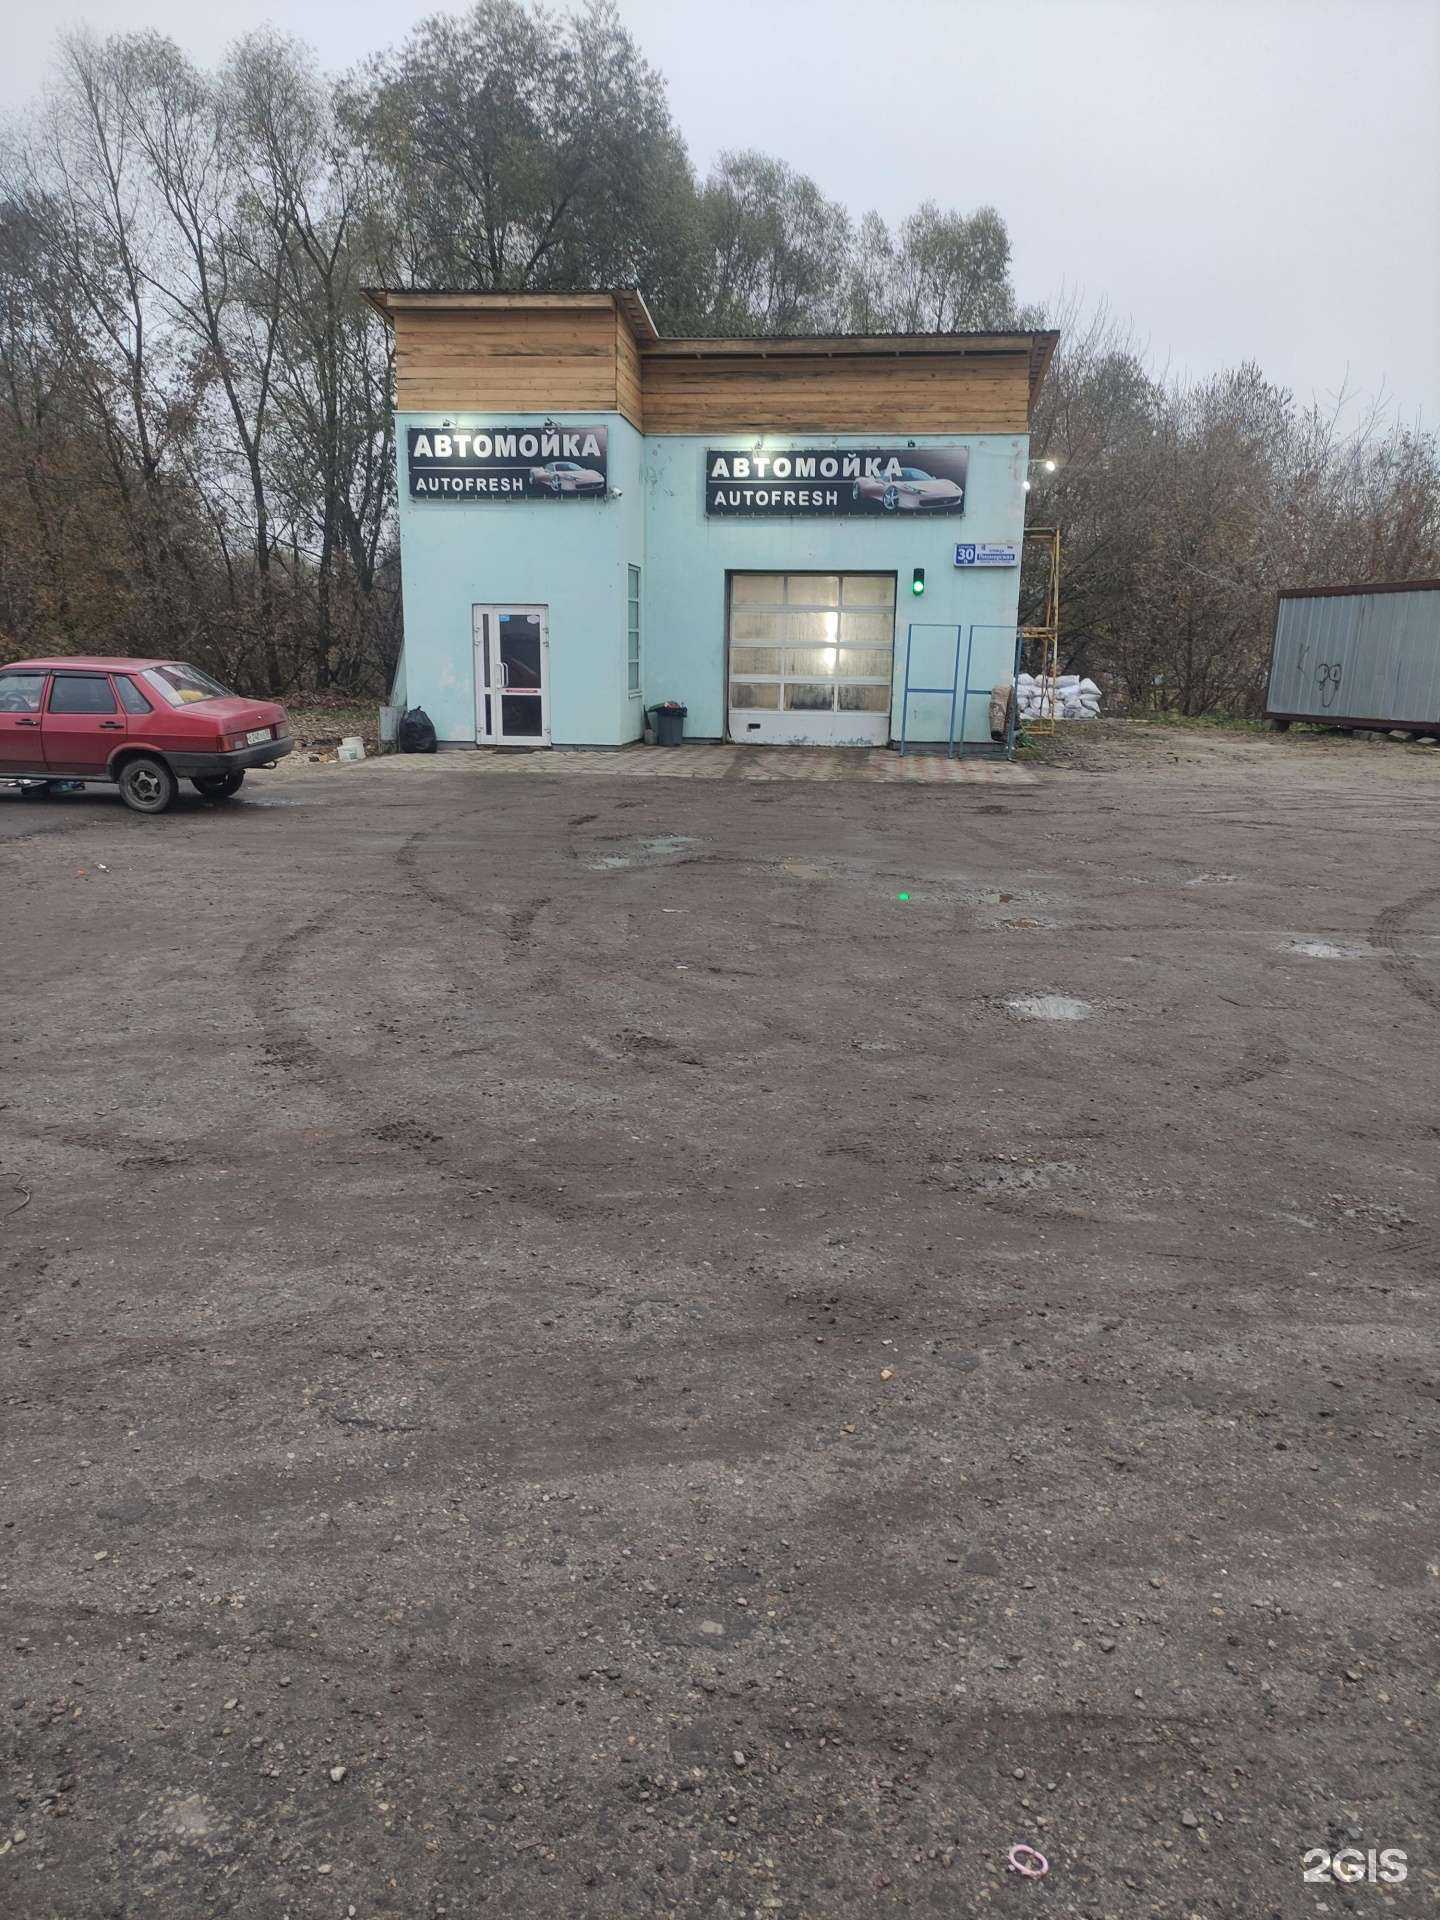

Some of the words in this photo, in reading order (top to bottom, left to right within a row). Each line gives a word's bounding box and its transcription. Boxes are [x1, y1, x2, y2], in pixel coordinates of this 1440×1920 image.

[413, 429, 601, 458] АВТОМОЙКА
[711, 453, 903, 478] АВТОМОЙКА
[416, 477, 524, 492] AUTOFRESH
[714, 490, 839, 507] AUTOFRESH
[958, 549, 974, 560] 30
